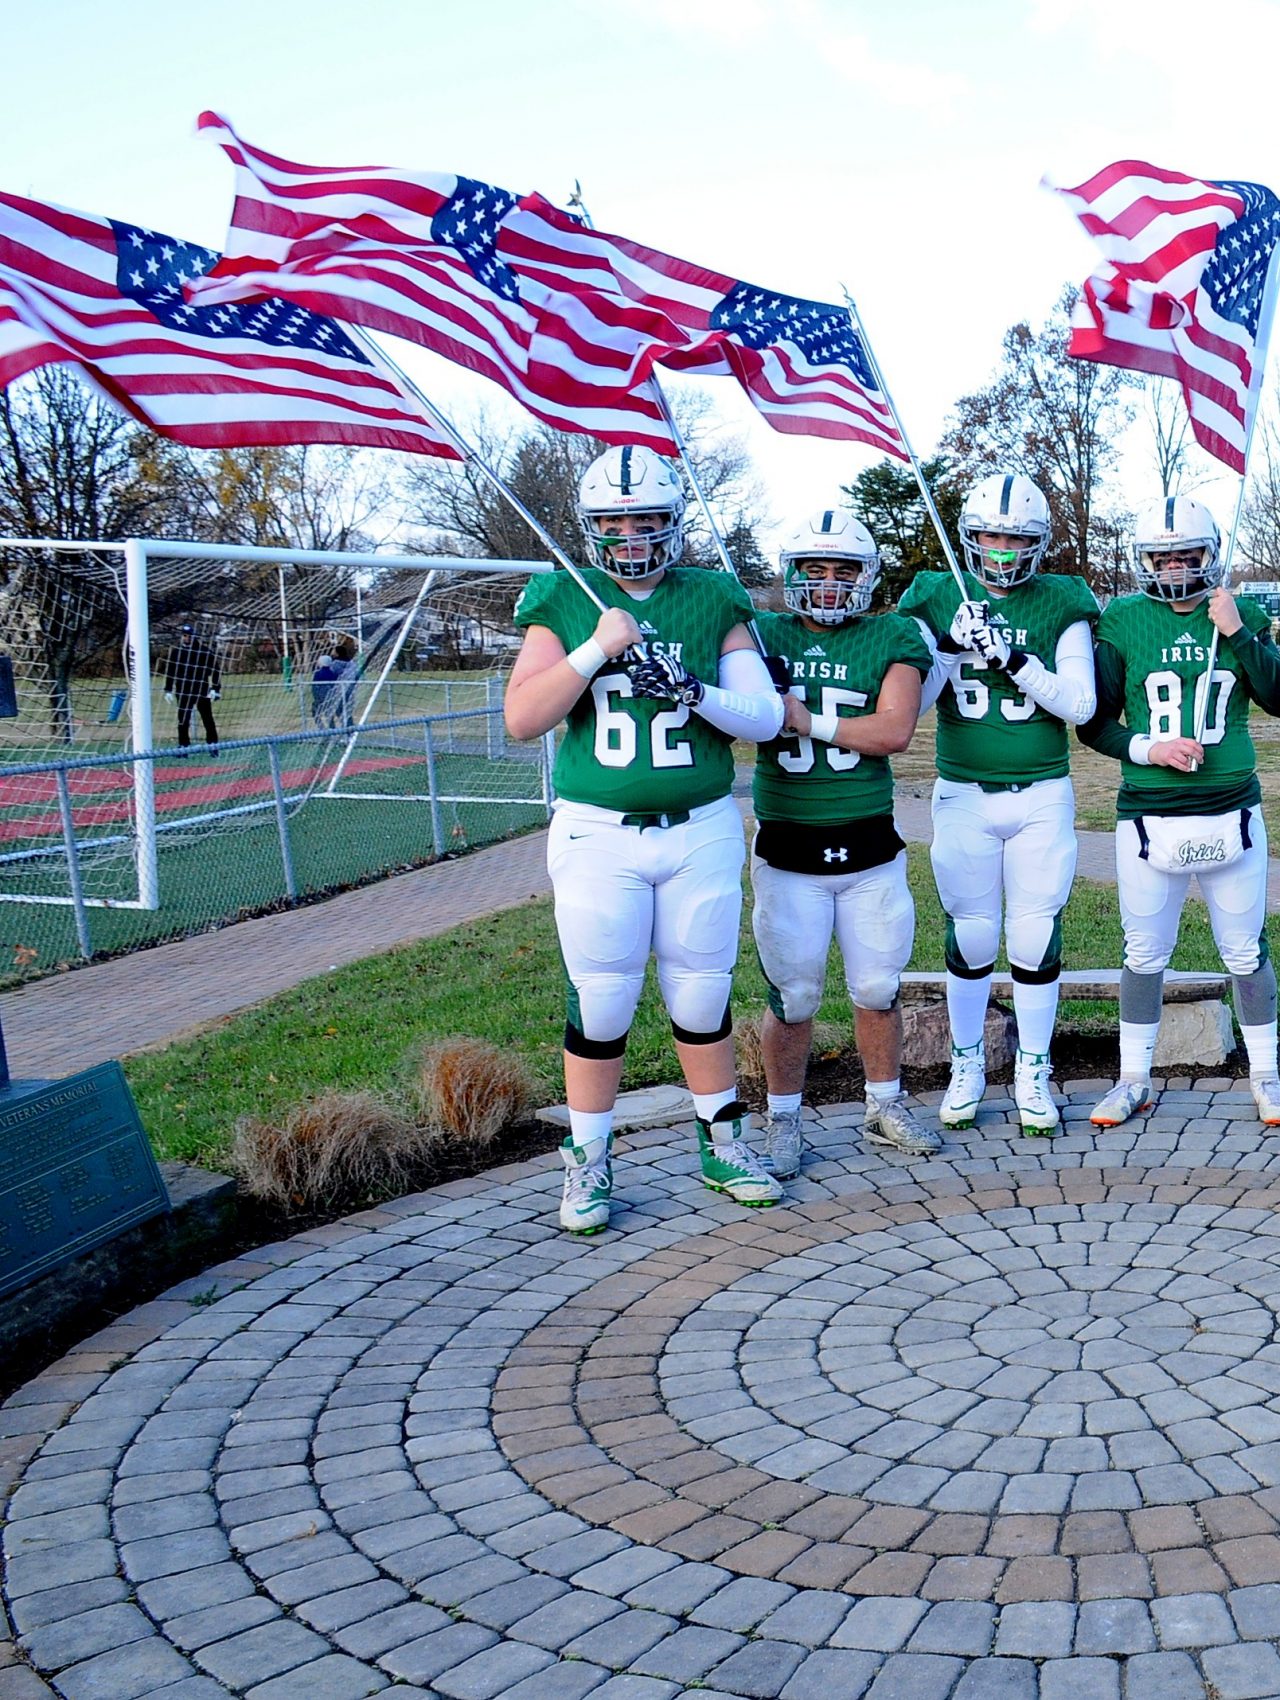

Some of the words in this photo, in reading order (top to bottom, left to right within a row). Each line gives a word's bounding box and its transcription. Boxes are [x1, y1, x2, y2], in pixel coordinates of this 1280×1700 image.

[785, 661, 848, 681] RISH
[590, 673, 694, 769] 62
[1144, 670, 1237, 745] 80
[1179, 838, 1226, 867] Irish
[0, 1099, 51, 1128] VETERANS
[50, 1080, 98, 1107] MEMORIAL
